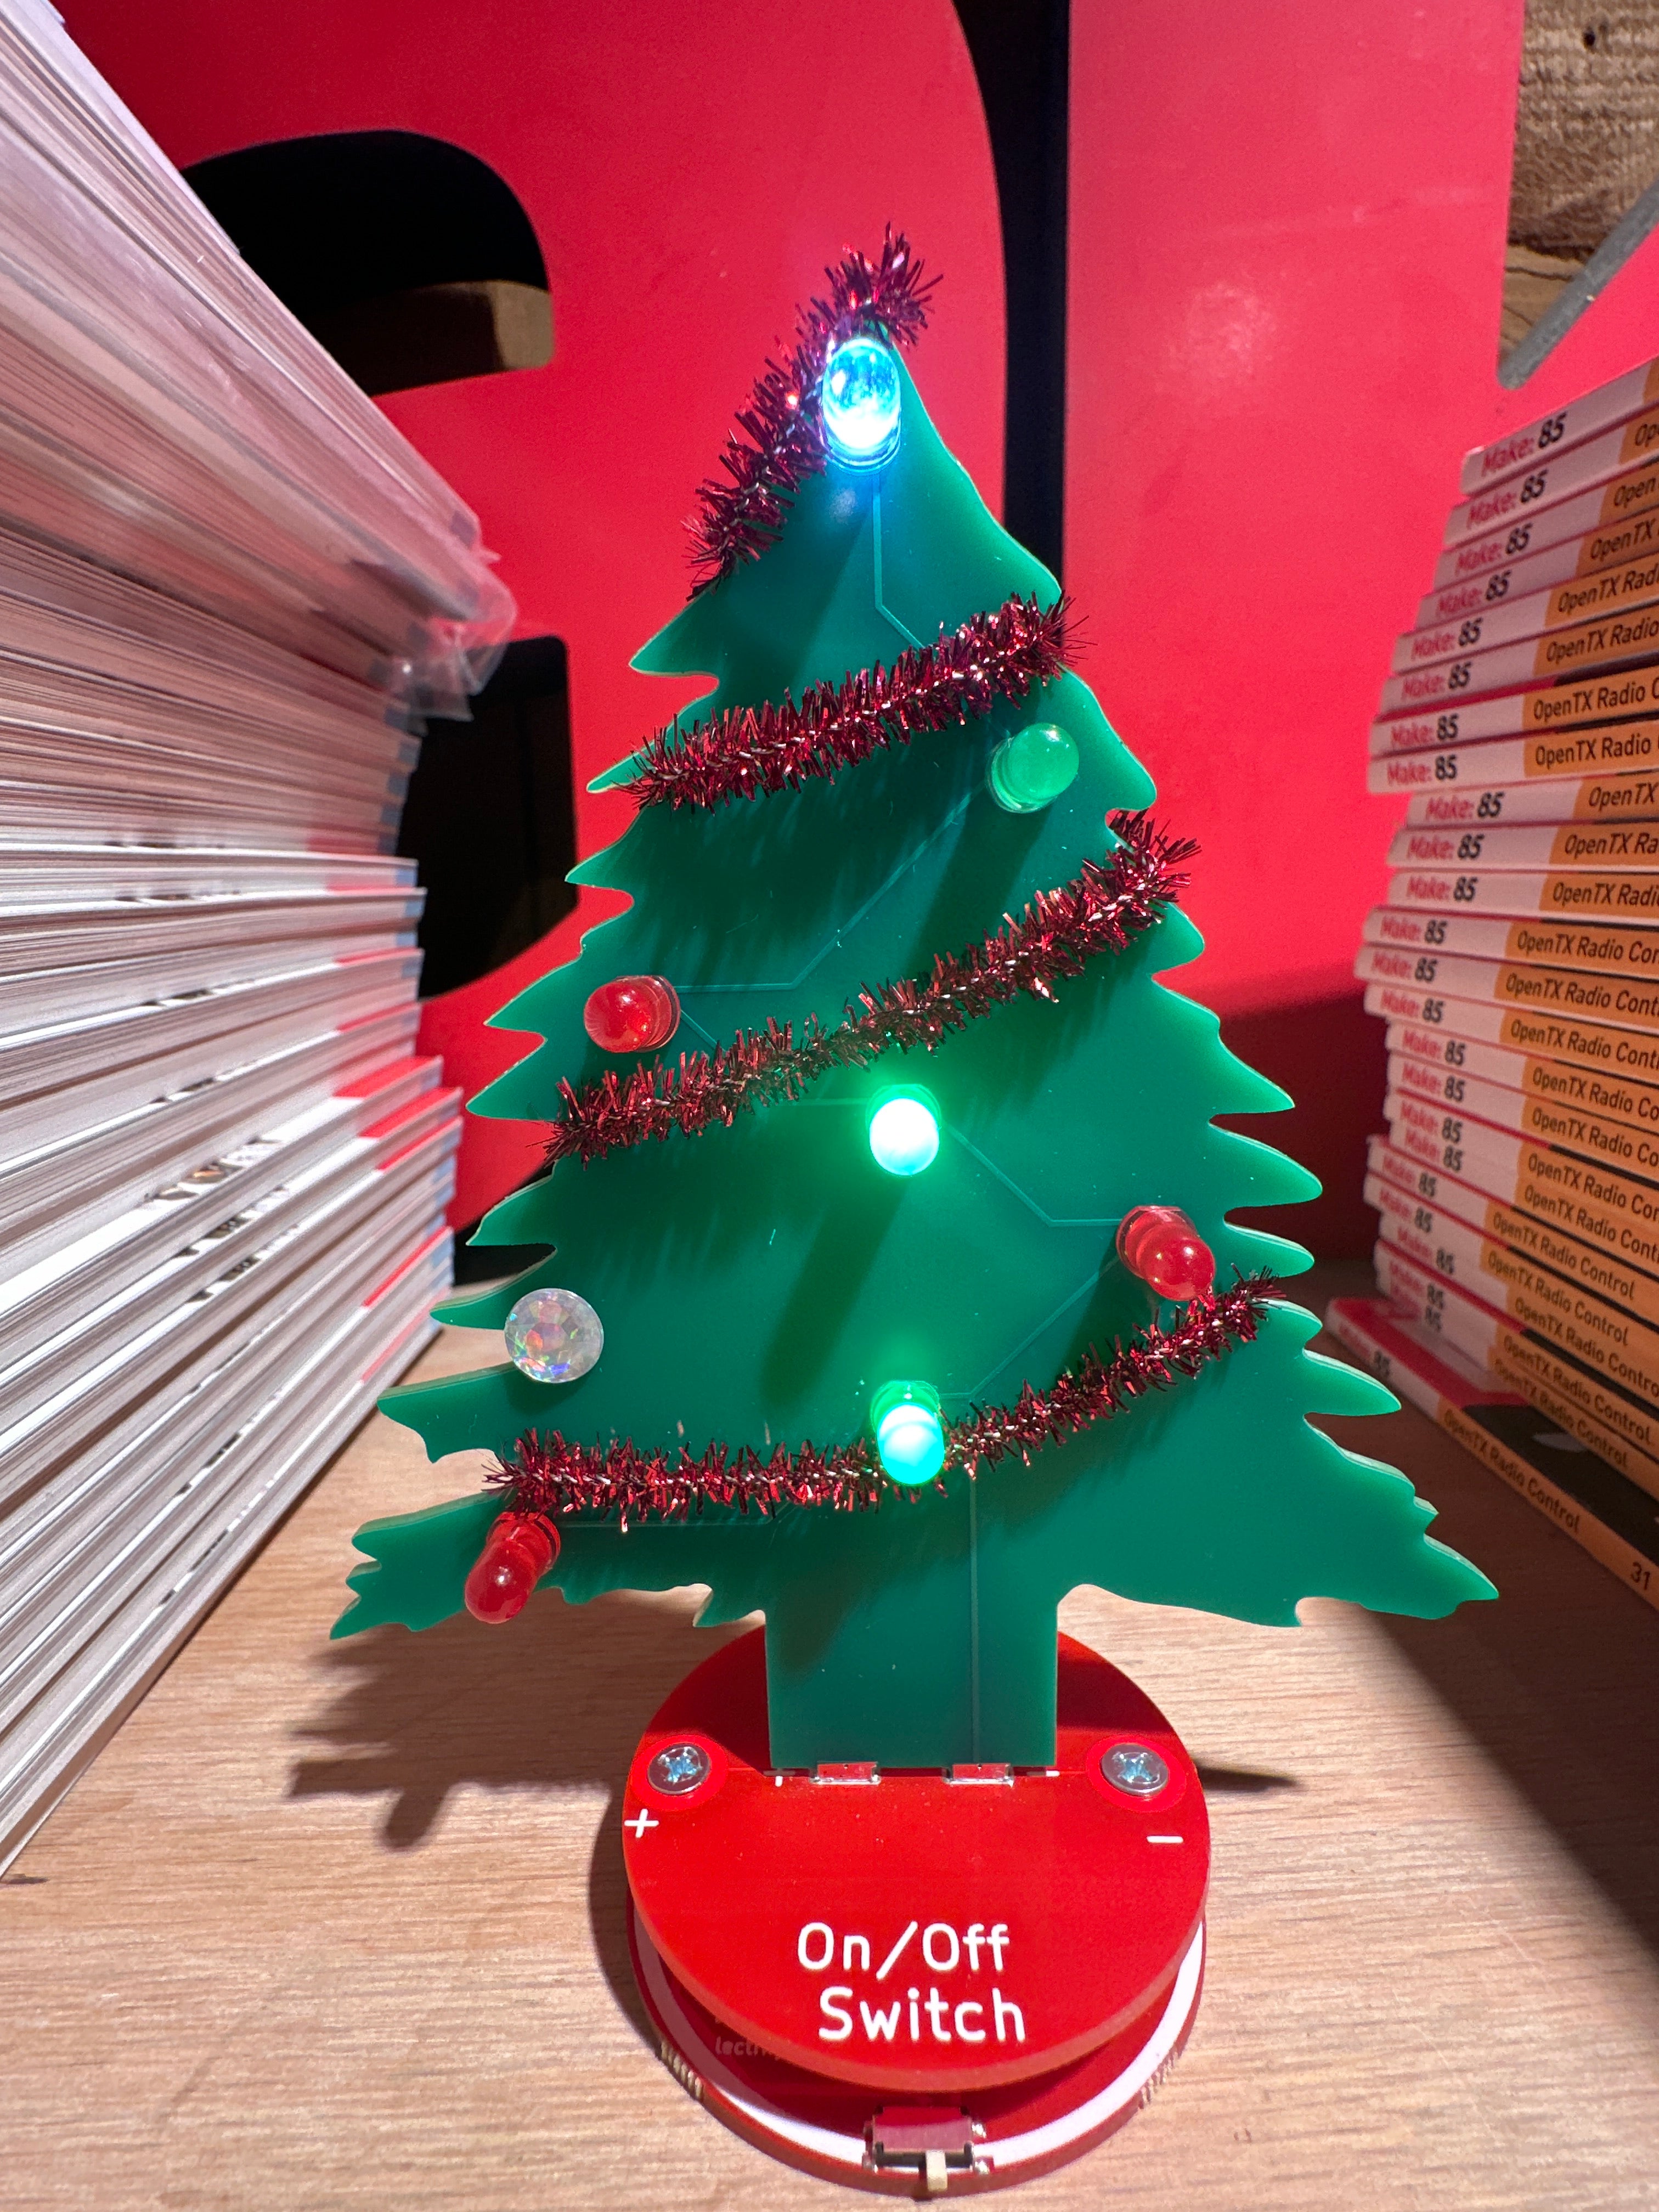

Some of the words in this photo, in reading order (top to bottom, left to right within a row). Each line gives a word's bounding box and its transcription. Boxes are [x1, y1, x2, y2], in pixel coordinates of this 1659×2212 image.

[1539, 412, 1566, 449] 85
[1521, 470, 1548, 503] 85
[1486, 569, 1513, 601] 85
[1590, 517, 1656, 562] OpenTX
[1505, 523, 1533, 554] 85
[1458, 617, 1483, 646] 85
[1558, 574, 1620, 616] OpenTX
[1448, 661, 1472, 690] 85
[1546, 628, 1609, 665] OpenTX
[1436, 713, 1458, 741] 85
[1533, 689, 1594, 725] OpenTX
[1597, 681, 1646, 710] Radio
[1435, 754, 1457, 781] 85
[1535, 738, 1597, 770] OpenTX
[1601, 733, 1651, 759] Radio
[1477, 792, 1504, 818] 85
[1588, 782, 1659, 812] OpenTX
[1457, 833, 1485, 860] 85
[1564, 832, 1634, 860] OpenTX
[1454, 877, 1478, 901] 85
[1553, 881, 1617, 908] OpenTX
[1424, 918, 1448, 945] 85
[1517, 930, 1576, 955] OpenTX
[1576, 935, 1624, 960] Radio
[1414, 957, 1438, 983] 85
[1505, 972, 1564, 1000] OpenTX
[1564, 981, 1611, 1008] Radio
[1422, 998, 1444, 1024] 85
[1511, 1018, 1566, 1048] OpenTX
[1567, 1030, 1611, 1059] Radio
[1445, 1040, 1465, 1066] 85
[1532, 1066, 1587, 1099] OpenTX
[1589, 1083, 1633, 1113] Radio
[1444, 1076, 1465, 1103] 85
[1532, 1107, 1587, 1142] OpenTX
[1589, 1125, 1633, 1158] Radio
[1442, 1117, 1463, 1144] 85
[1528, 1153, 1583, 1190] OpenTX
[1583, 1175, 1627, 1209] Radio
[1443, 1145, 1463, 1172] 85
[1524, 1183, 1574, 1222] OpenTX
[1576, 1207, 1616, 1242] Radio
[1493, 1211, 1538, 1250] OpenTX
[1541, 1235, 1577, 1269] Radio
[1580, 1256, 1635, 1301] Control
[1487, 1250, 1533, 1291] OpenTX
[1536, 1278, 1572, 1314] Radio
[1575, 1300, 1629, 1346] Control
[1515, 1296, 1562, 1340] OpenTX
[1565, 1326, 1605, 1364] Radio
[1503, 1334, 1551, 1378] OpenTX
[1552, 1365, 1590, 1406] Radio
[1594, 1393, 1652, 1446] Control
[1576, 1418, 1629, 1469] Control
[1527, 1476, 1582, 1534] Control
[1629, 1561, 1650, 1592] 31
[797, 1920, 1009, 1979] On/Off
[819, 1985, 1026, 2042] Switch
